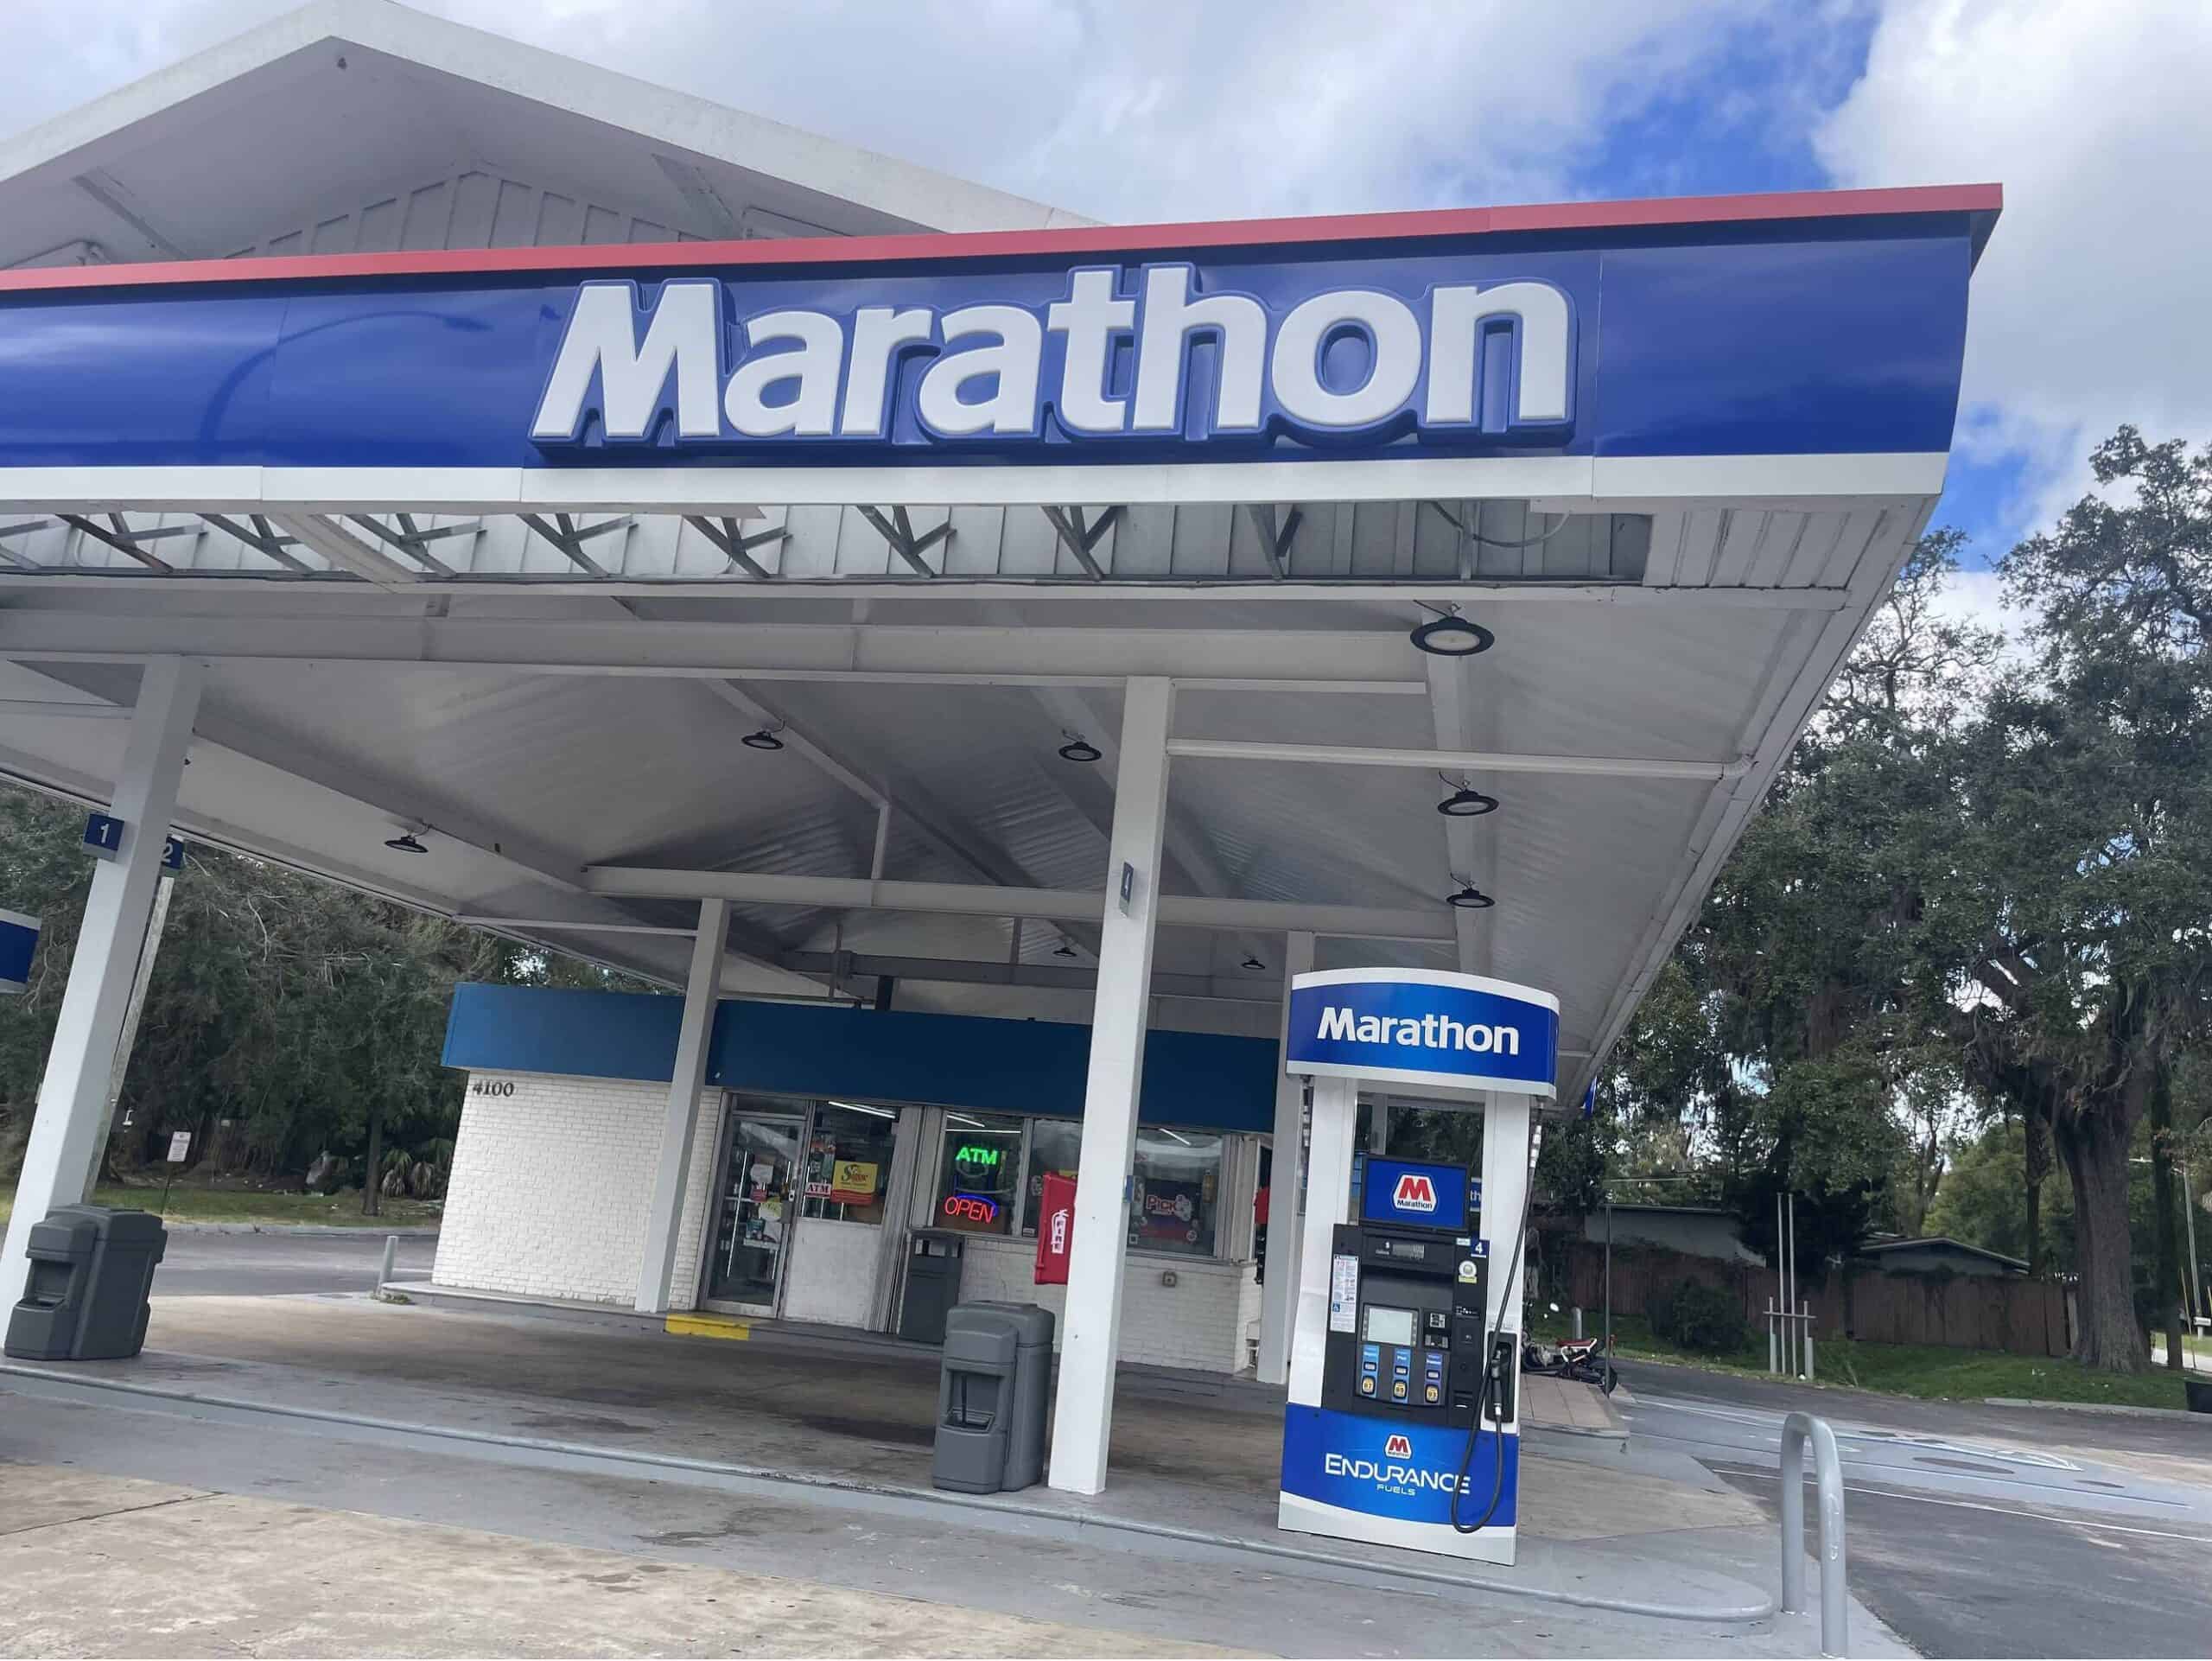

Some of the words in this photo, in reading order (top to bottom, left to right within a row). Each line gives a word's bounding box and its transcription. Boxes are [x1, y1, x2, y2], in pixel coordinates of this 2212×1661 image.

[531, 264, 1571, 441] Marathon
[99, 823, 110, 844] 1
[160, 842, 175, 863] 2
[1316, 1006, 1520, 1056] Marathon
[472, 1081, 514, 1097] 4100
[955, 1147, 998, 1166] ATM
[807, 1183, 830, 1194] ATM
[944, 1196, 995, 1224] OPEN
[1396, 1199, 1433, 1210] Marathon
[1475, 1242, 1484, 1254] 4
[1325, 1453, 1471, 1494] ENDURANCE
[1376, 1484, 1415, 1496] FUELS
